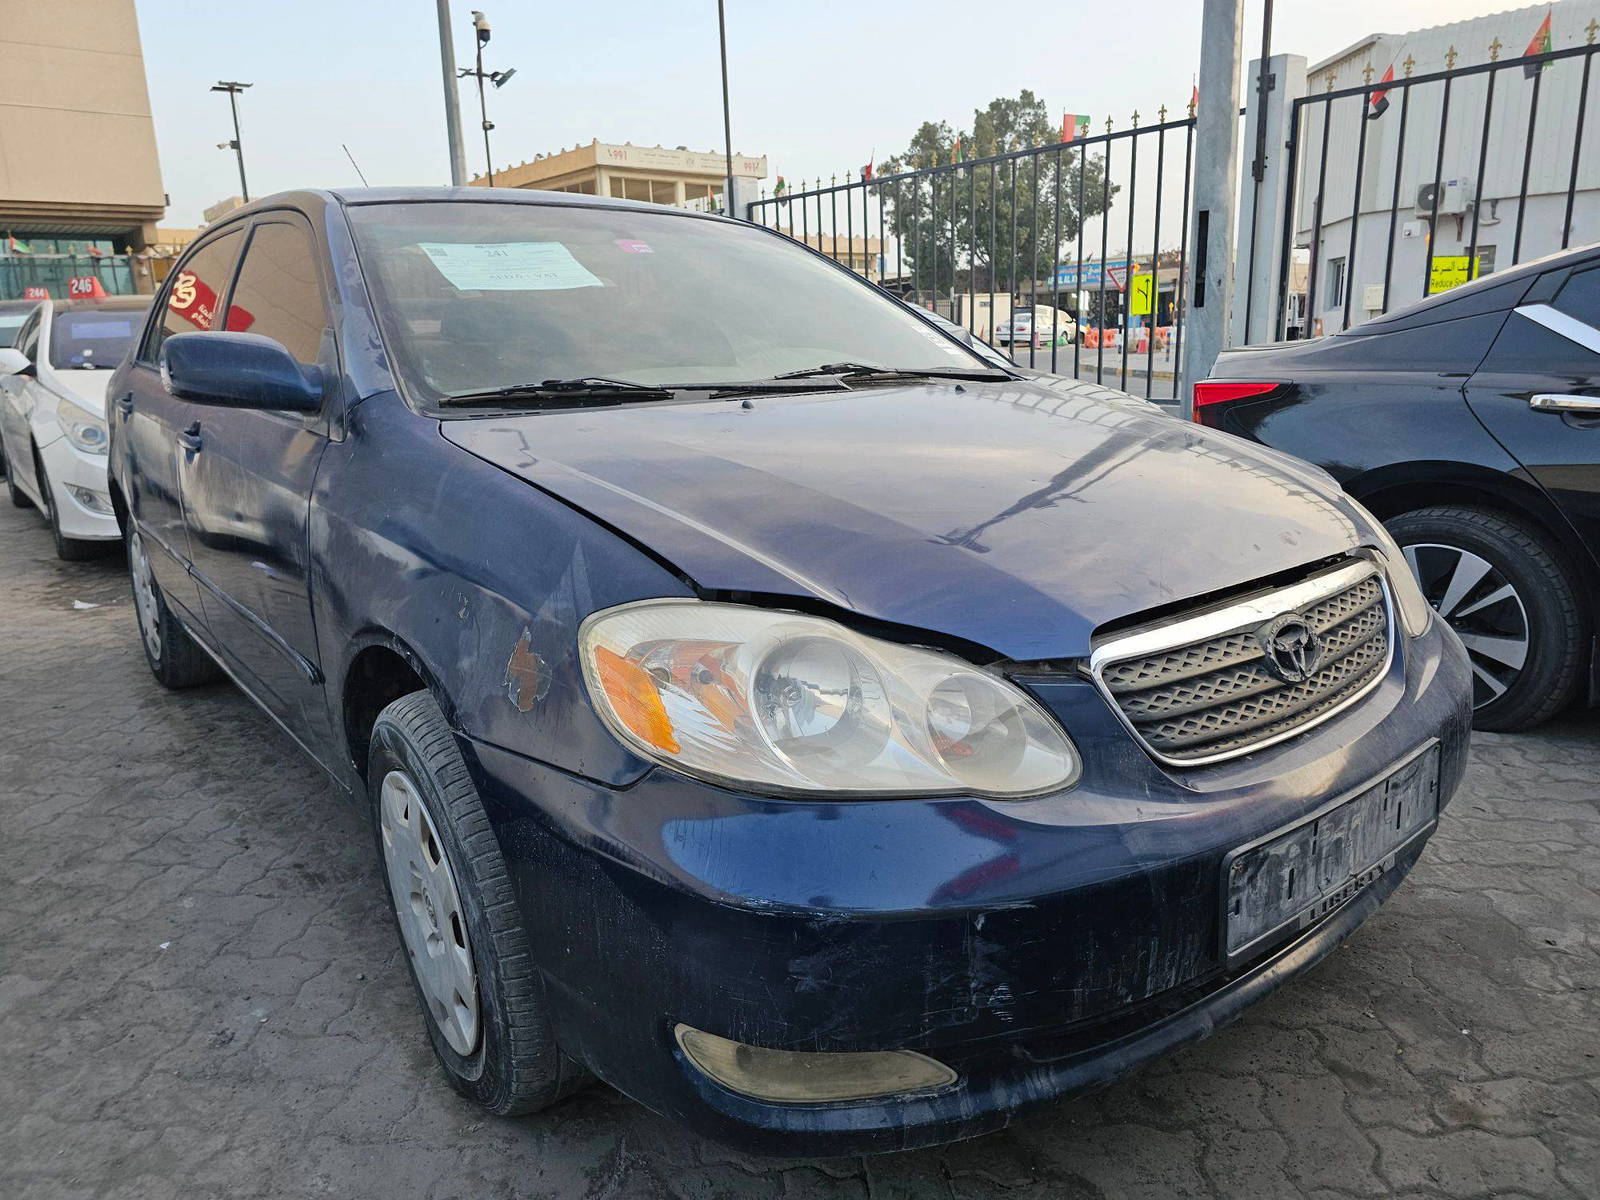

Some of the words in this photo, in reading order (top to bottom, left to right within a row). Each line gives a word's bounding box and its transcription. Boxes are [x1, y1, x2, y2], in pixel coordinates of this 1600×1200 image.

[72, 279, 92, 293] 246
[1431, 279, 1452, 288] Reduce
[1309, 861, 1386, 918] LIBERTY
